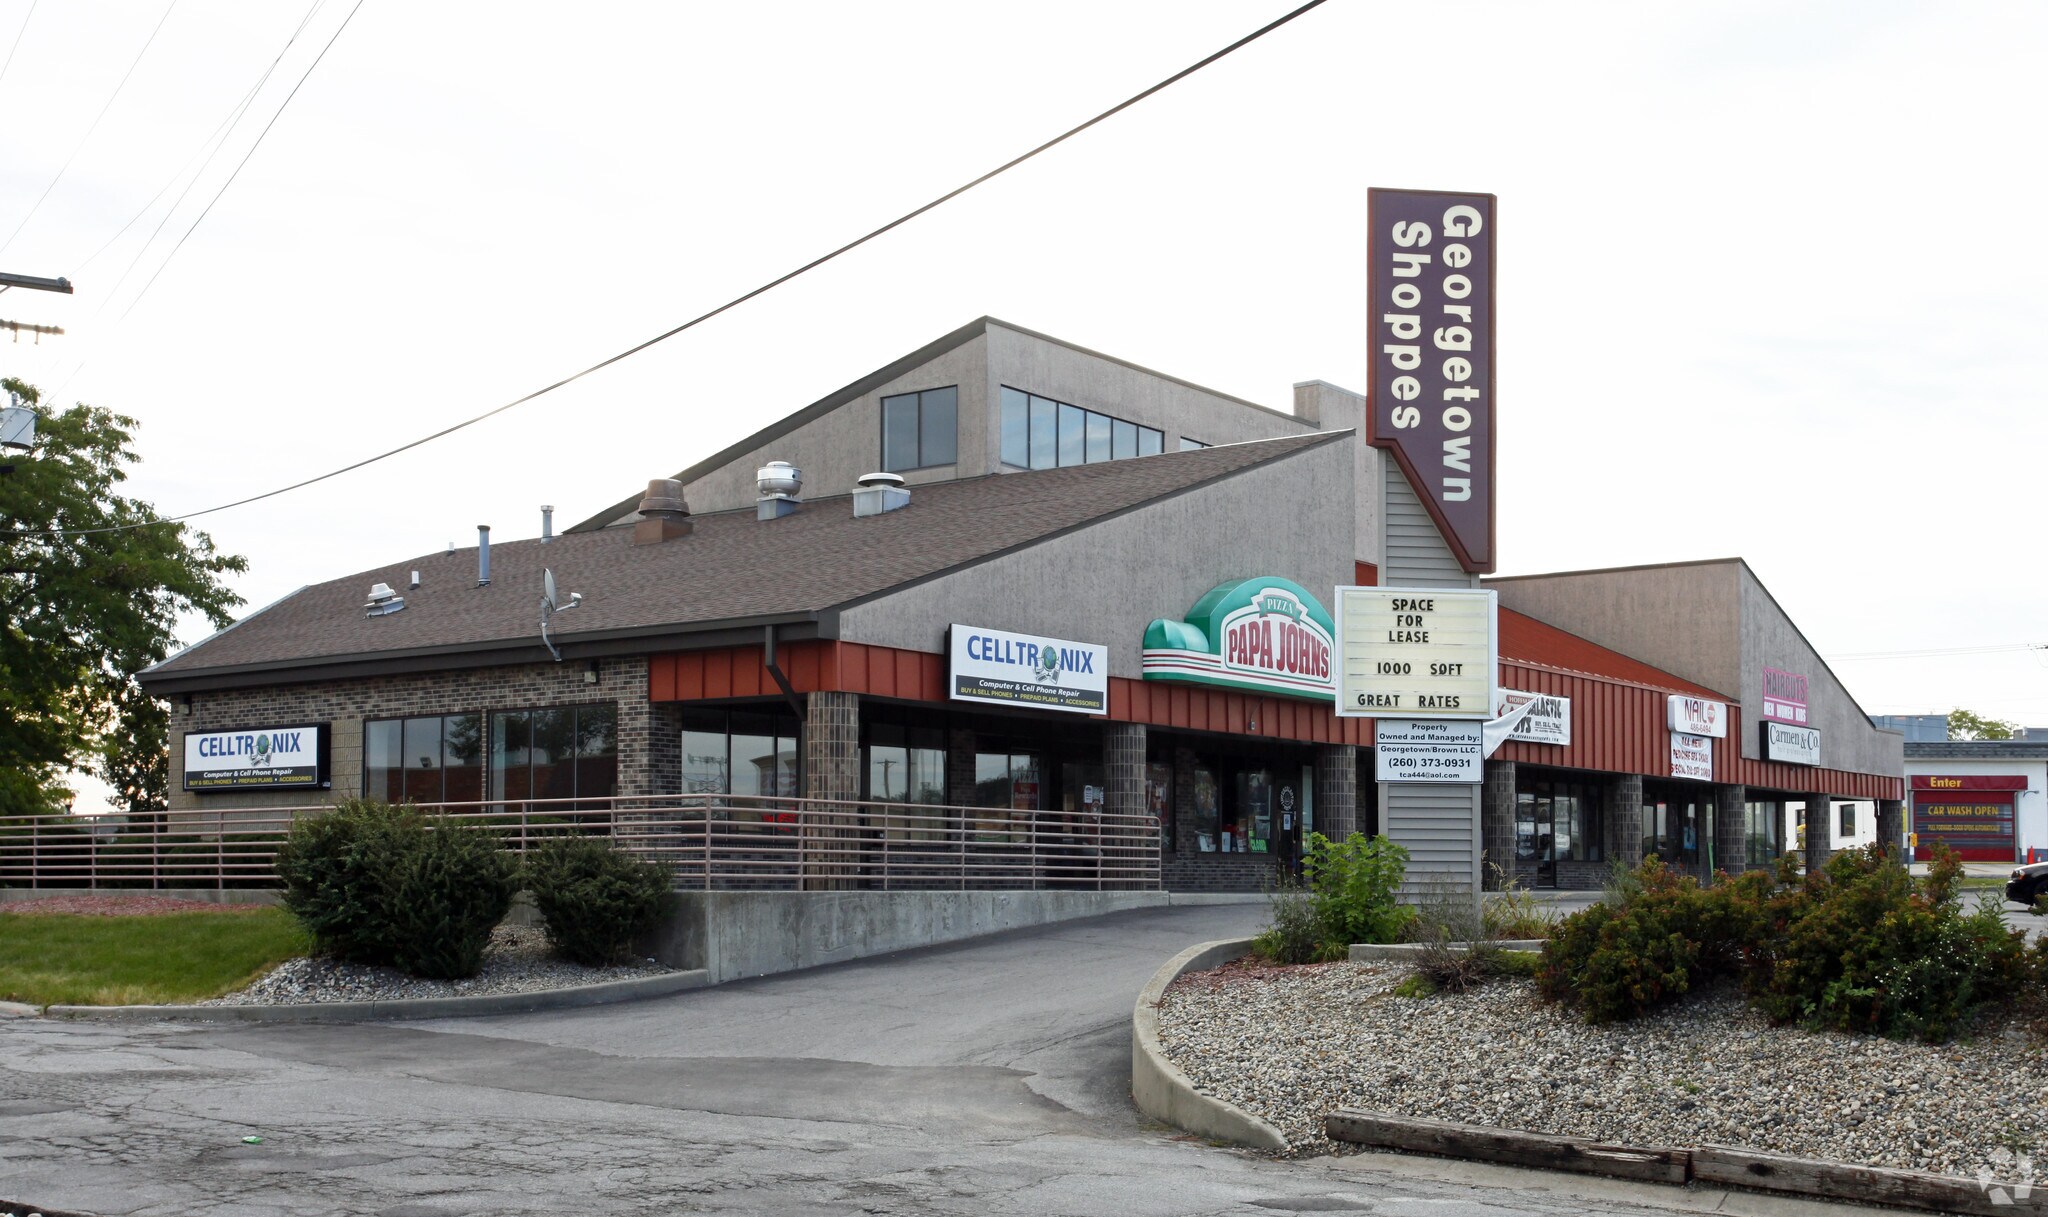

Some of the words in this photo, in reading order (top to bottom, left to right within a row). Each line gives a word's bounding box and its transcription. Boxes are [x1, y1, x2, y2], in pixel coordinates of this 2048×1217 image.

[1383, 220, 1433, 429] Shoppes
[1433, 204, 1483, 502] Georgetown
[1267, 598, 1294, 614] PIZZA
[1391, 599, 1434, 611] SPACE
[1396, 615, 1423, 627] FOR
[1388, 630, 1430, 643] LEASE
[1228, 620, 1274, 669] PAPA
[1377, 662, 1412, 675] 1000
[978, 679, 1014, 690] Computer
[1021, 684, 1035, 692] Cell
[1036, 686, 1057, 695] Phone
[1057, 688, 1080, 698] Repair
[1765, 672, 1806, 702] HAIRCUTS
[960, 686, 973, 694] BUY
[977, 688, 991, 696] SELL
[991, 690, 1013, 698] PHONES
[1020, 693, 1042, 702] PREPAID
[1042, 695, 1059, 703] PLANS
[1065, 698, 1100, 707] ACCESSORIES
[1357, 694, 1400, 706] GREAT
[1418, 695, 1460, 708] RATES
[1684, 699, 1707, 723] NAIL
[1763, 701, 1775, 717] MEN
[1776, 703, 1794, 720] WOMEN
[1795, 707, 1806, 723] KIDS
[1411, 723, 1448, 732] Property
[1410, 733, 1426, 741] and
[1427, 733, 1465, 743] Managed
[1467, 734, 1480, 742] by:
[1682, 736, 1690, 746] ALL
[1770, 724, 1800, 746] Carmen
[1800, 733, 1807, 750] &
[1388, 757, 1418, 769] (260)
[1420, 758, 1471, 768] 373-0931
[203, 770, 233, 779] Computer
[233, 769, 238, 777] &
[239, 769, 252, 777] Cell
[252, 768, 272, 776] Phone
[272, 768, 294, 776] Repair
[1930, 777, 1962, 788] Enter
[1927, 806, 1945, 816] CAR
[1946, 806, 1972, 816] WASH
[1974, 806, 1999, 816] OPEN
